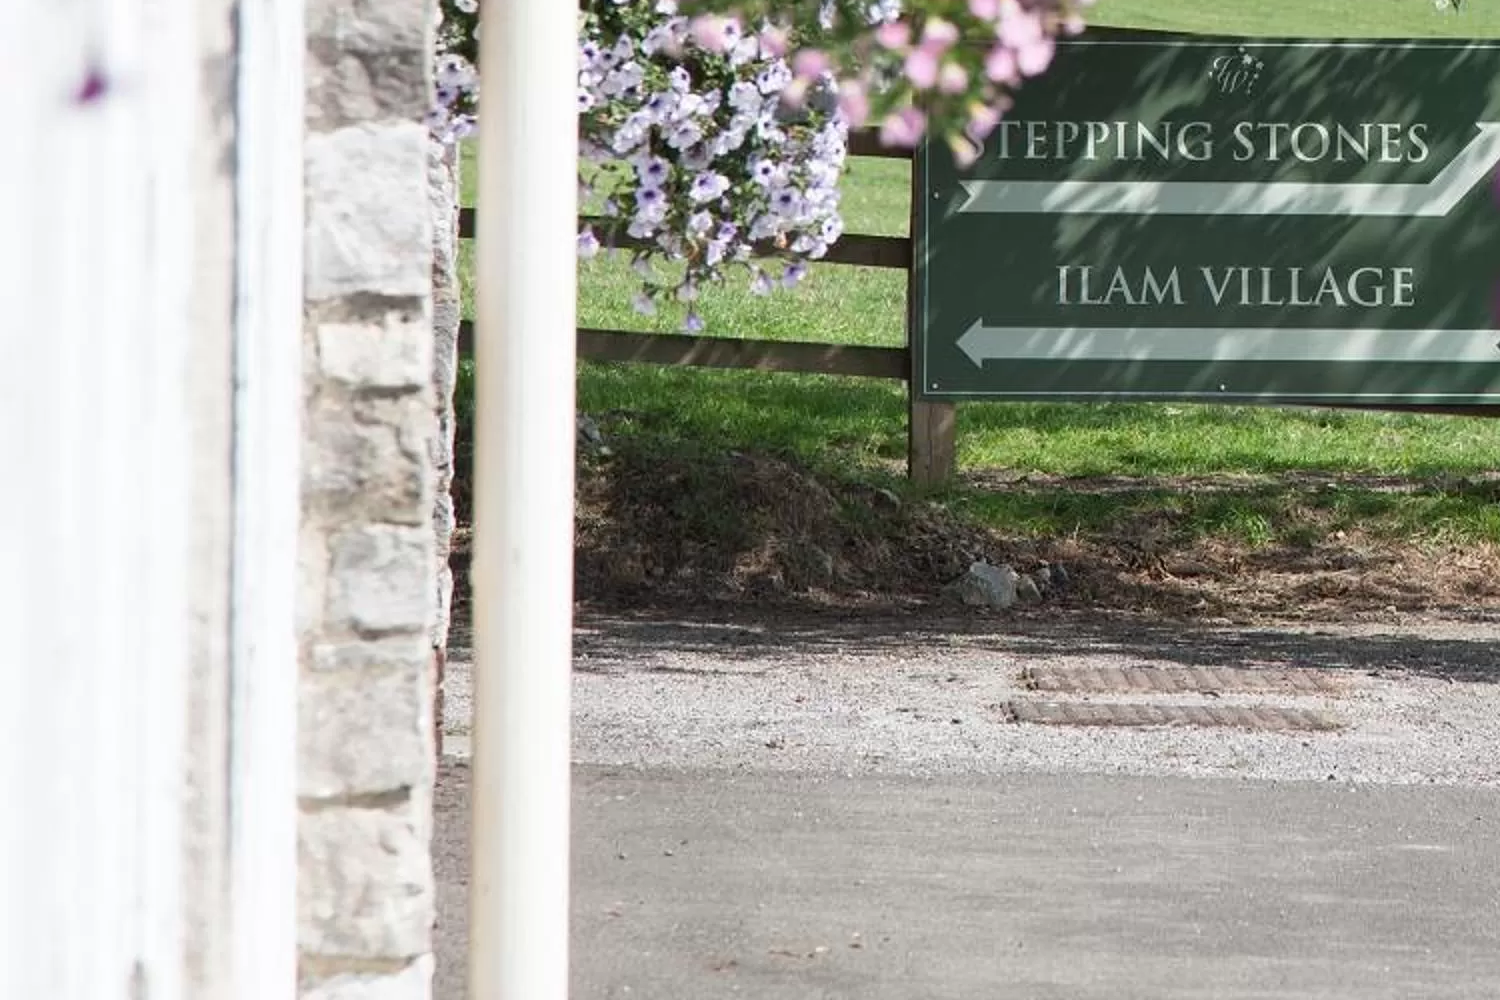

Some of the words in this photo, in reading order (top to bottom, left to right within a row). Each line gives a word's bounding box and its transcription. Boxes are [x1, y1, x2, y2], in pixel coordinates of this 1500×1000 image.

[1233, 121, 1429, 163] STONES
[1056, 264, 1184, 305] ILAM
[1200, 265, 1415, 308] VILLAGE
